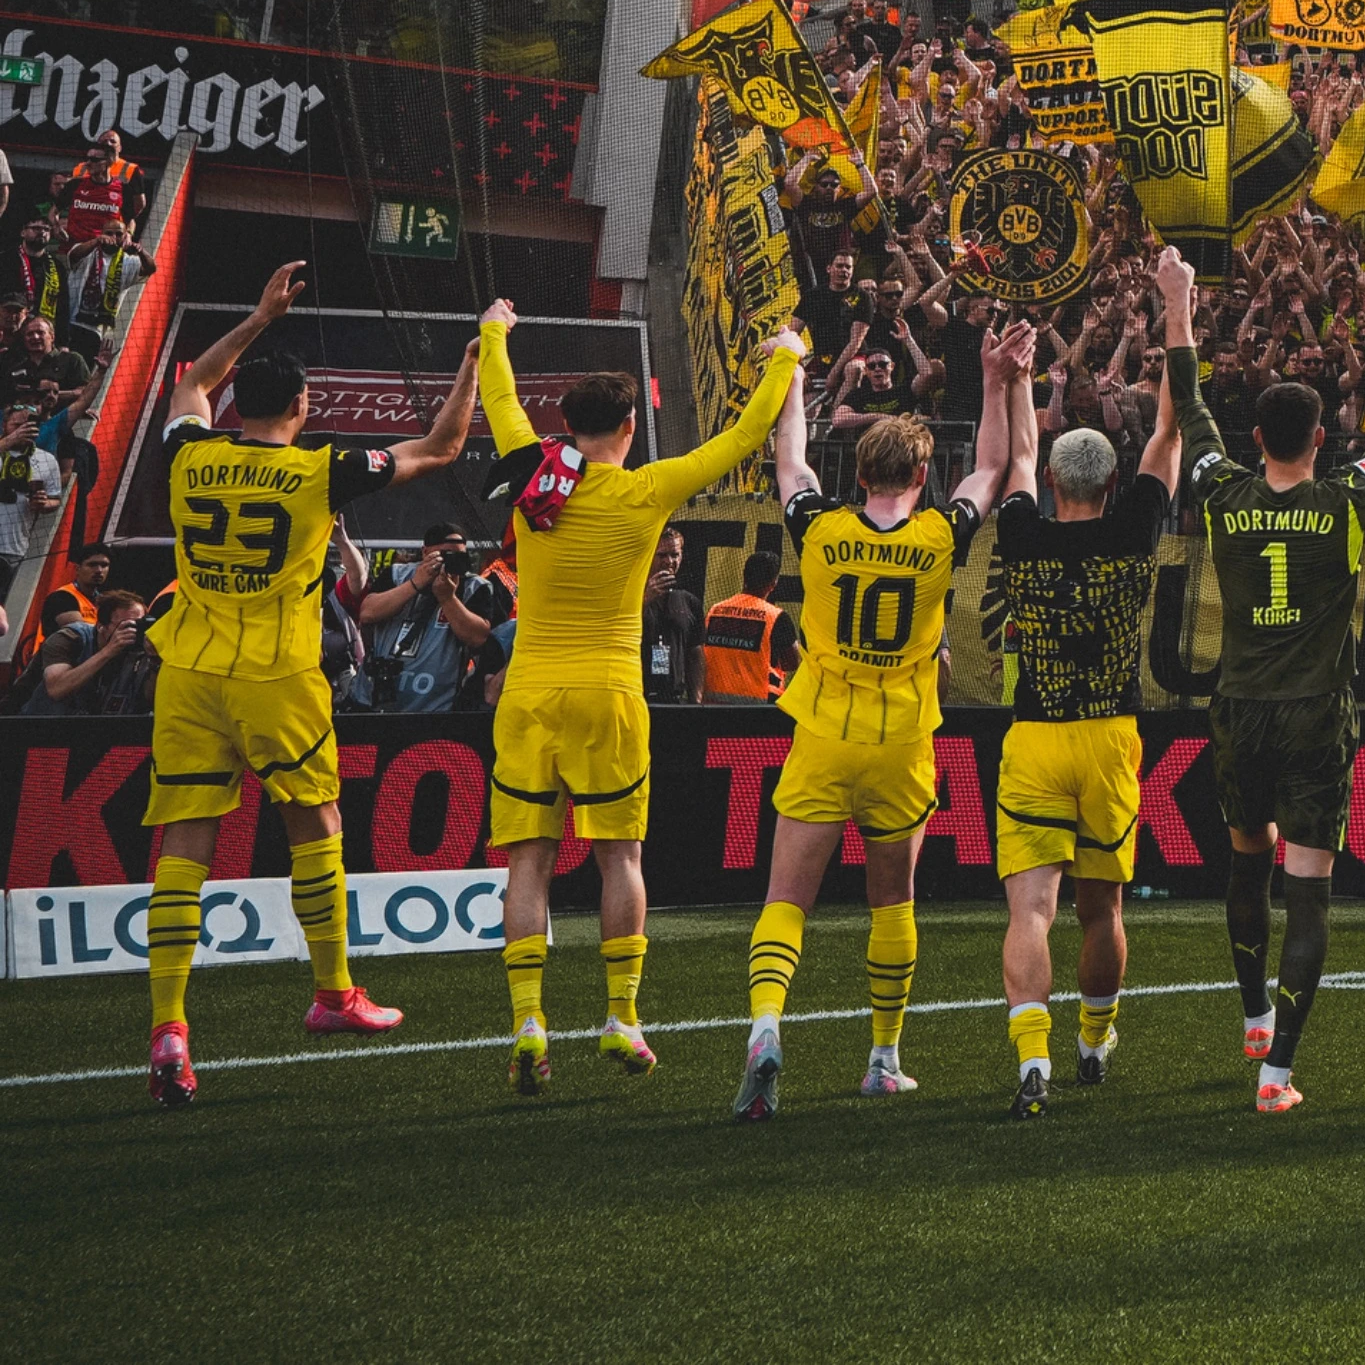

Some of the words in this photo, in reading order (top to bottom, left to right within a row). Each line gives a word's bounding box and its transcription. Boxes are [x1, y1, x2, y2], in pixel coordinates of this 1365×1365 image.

[956, 156, 1005, 194] THE
[1002, 207, 1039, 233] BVB
[1039, 263, 1082, 294] 2001
[302, 407, 484, 424] OFTWAE
[187, 465, 303, 494] DORTMUND
[182, 497, 292, 575] 23
[1223, 508, 1334, 535] DORTMUND
[823, 540, 936, 572] DORTMUND
[234, 573, 271, 594] CAN
[1260, 542, 1288, 610] 1
[832, 573, 916, 652] 10
[707, 635, 755, 650] SECURITAS
[36, 891, 276, 966] iLOQ
[348, 881, 508, 946] LOQ
